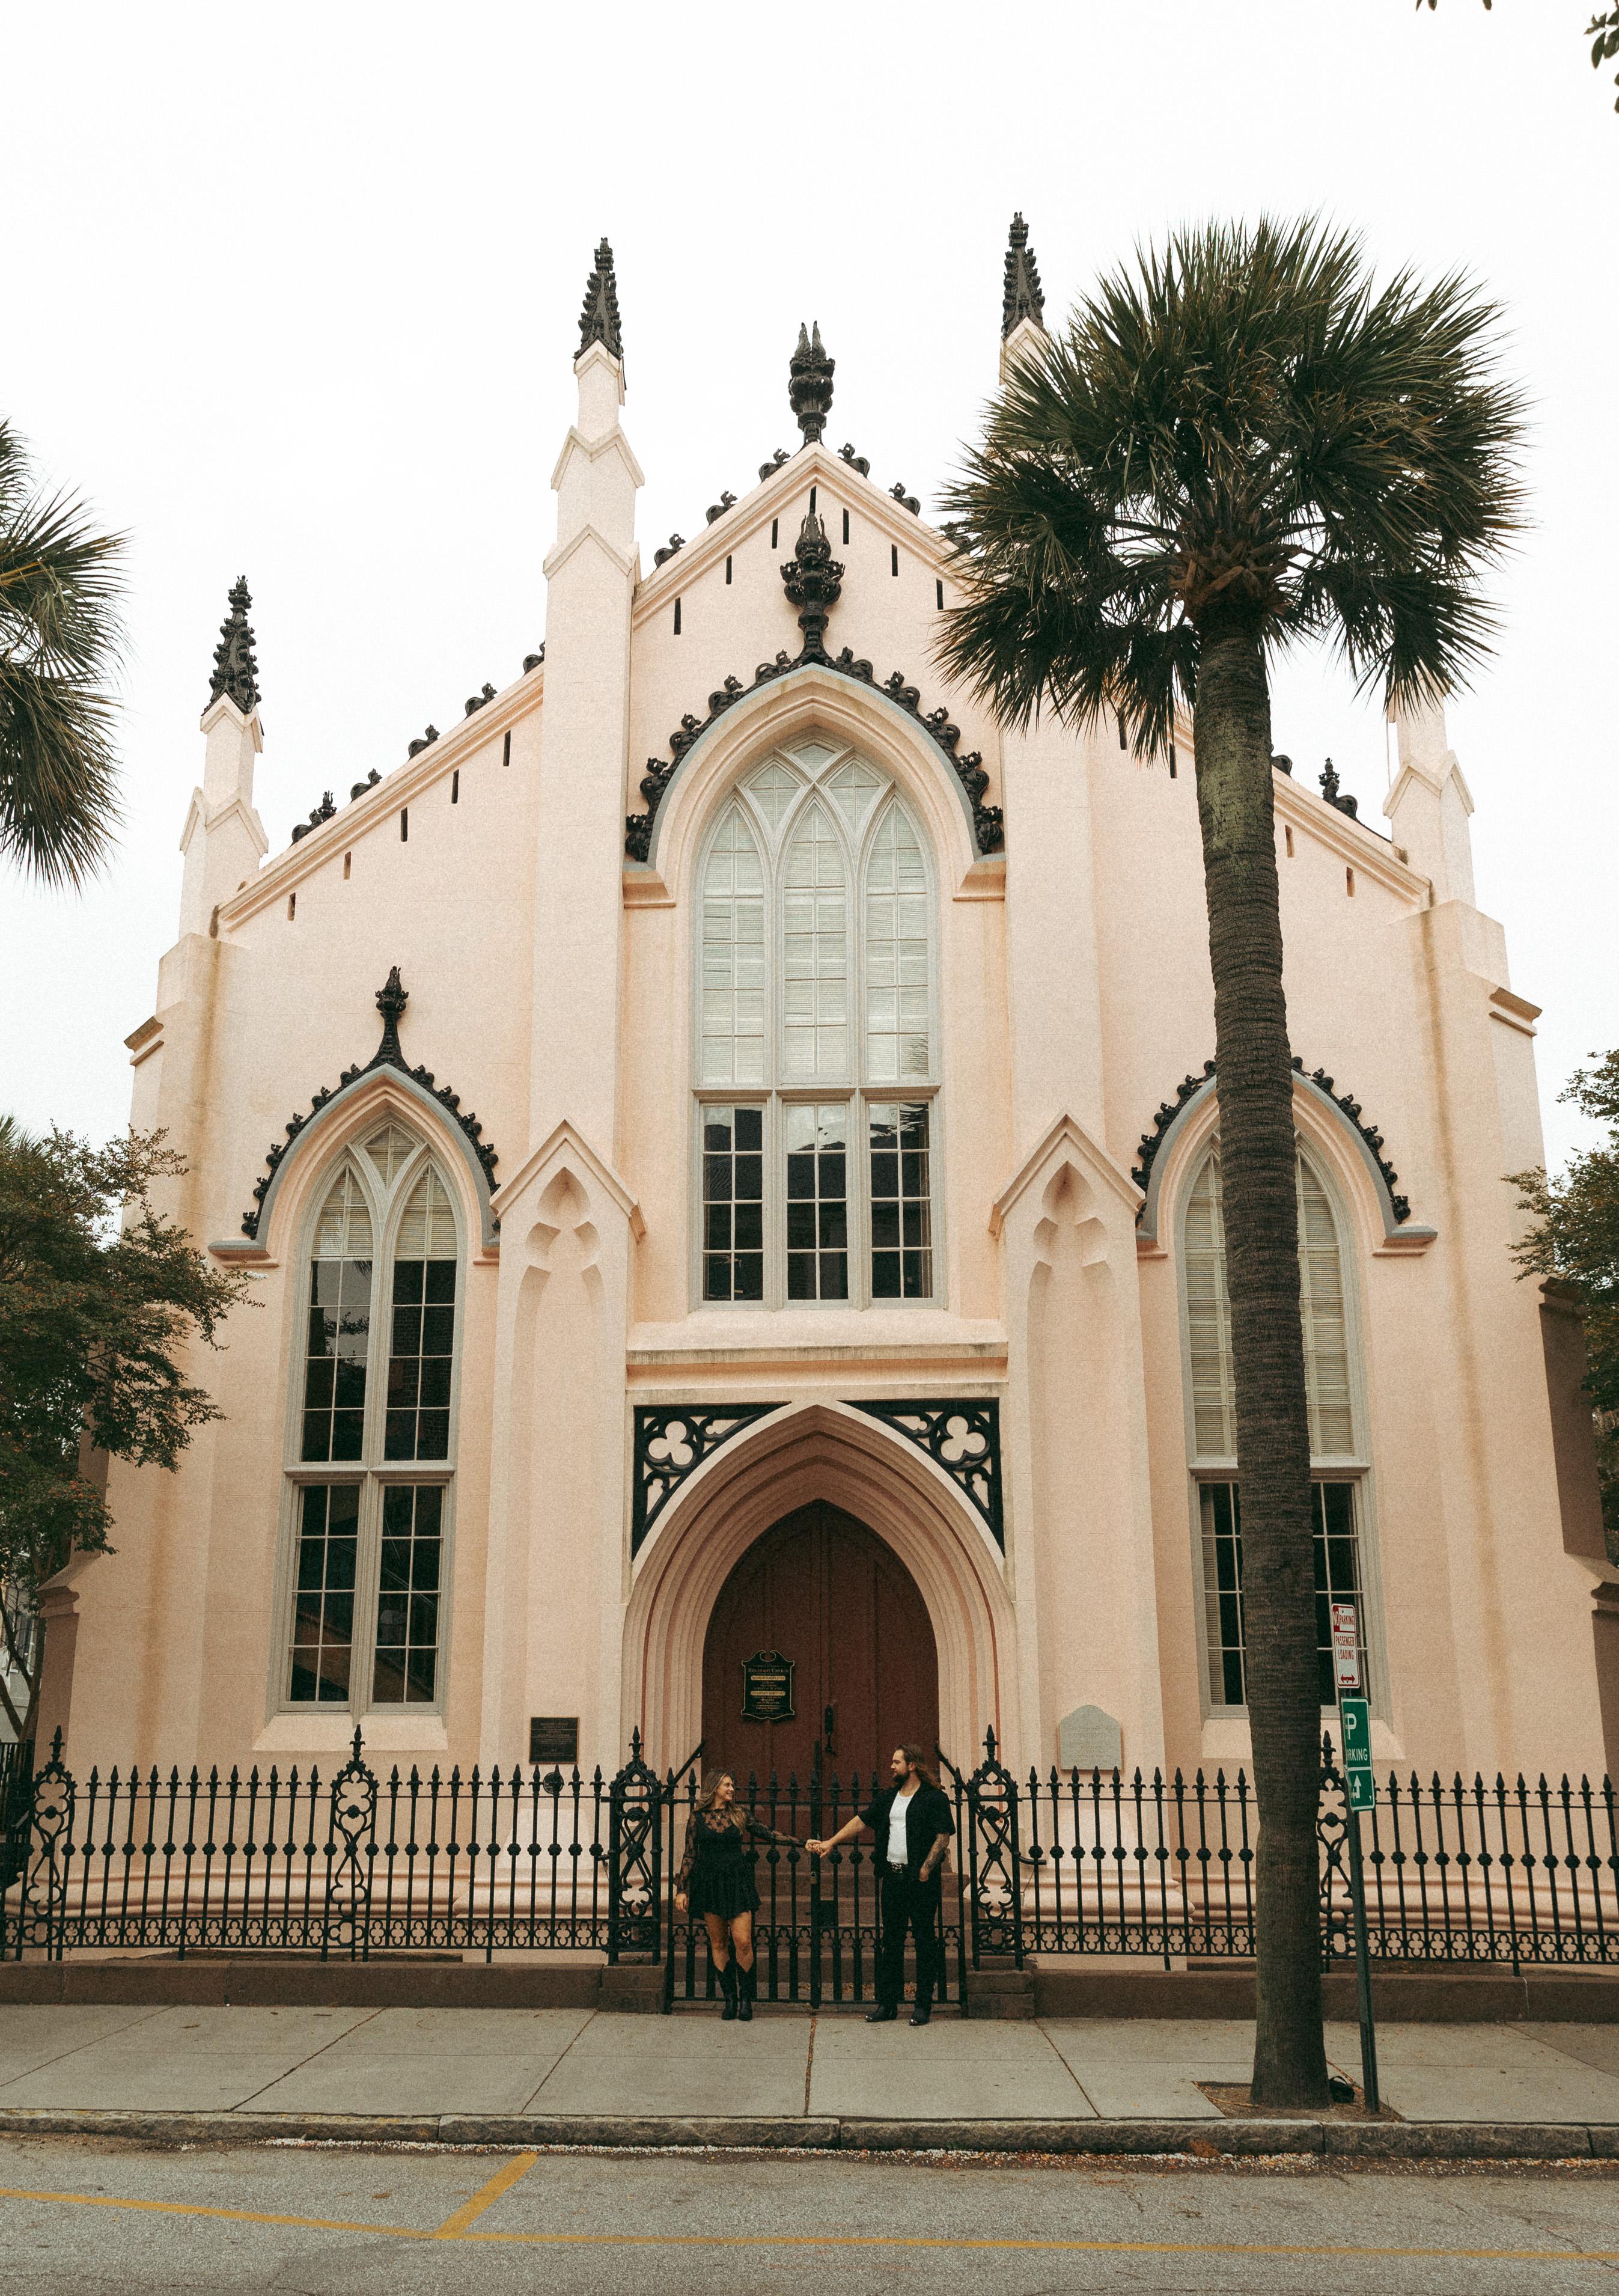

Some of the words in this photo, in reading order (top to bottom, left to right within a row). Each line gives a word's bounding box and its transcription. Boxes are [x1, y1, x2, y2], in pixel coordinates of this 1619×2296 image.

[1333, 1611, 1339, 1626] NO
[1339, 1615, 1355, 1625] PARKING
[1335, 1635, 1355, 1647] PASSENGER
[1338, 1649, 1354, 1660] LOADING
[1344, 1713, 1357, 1740] P
